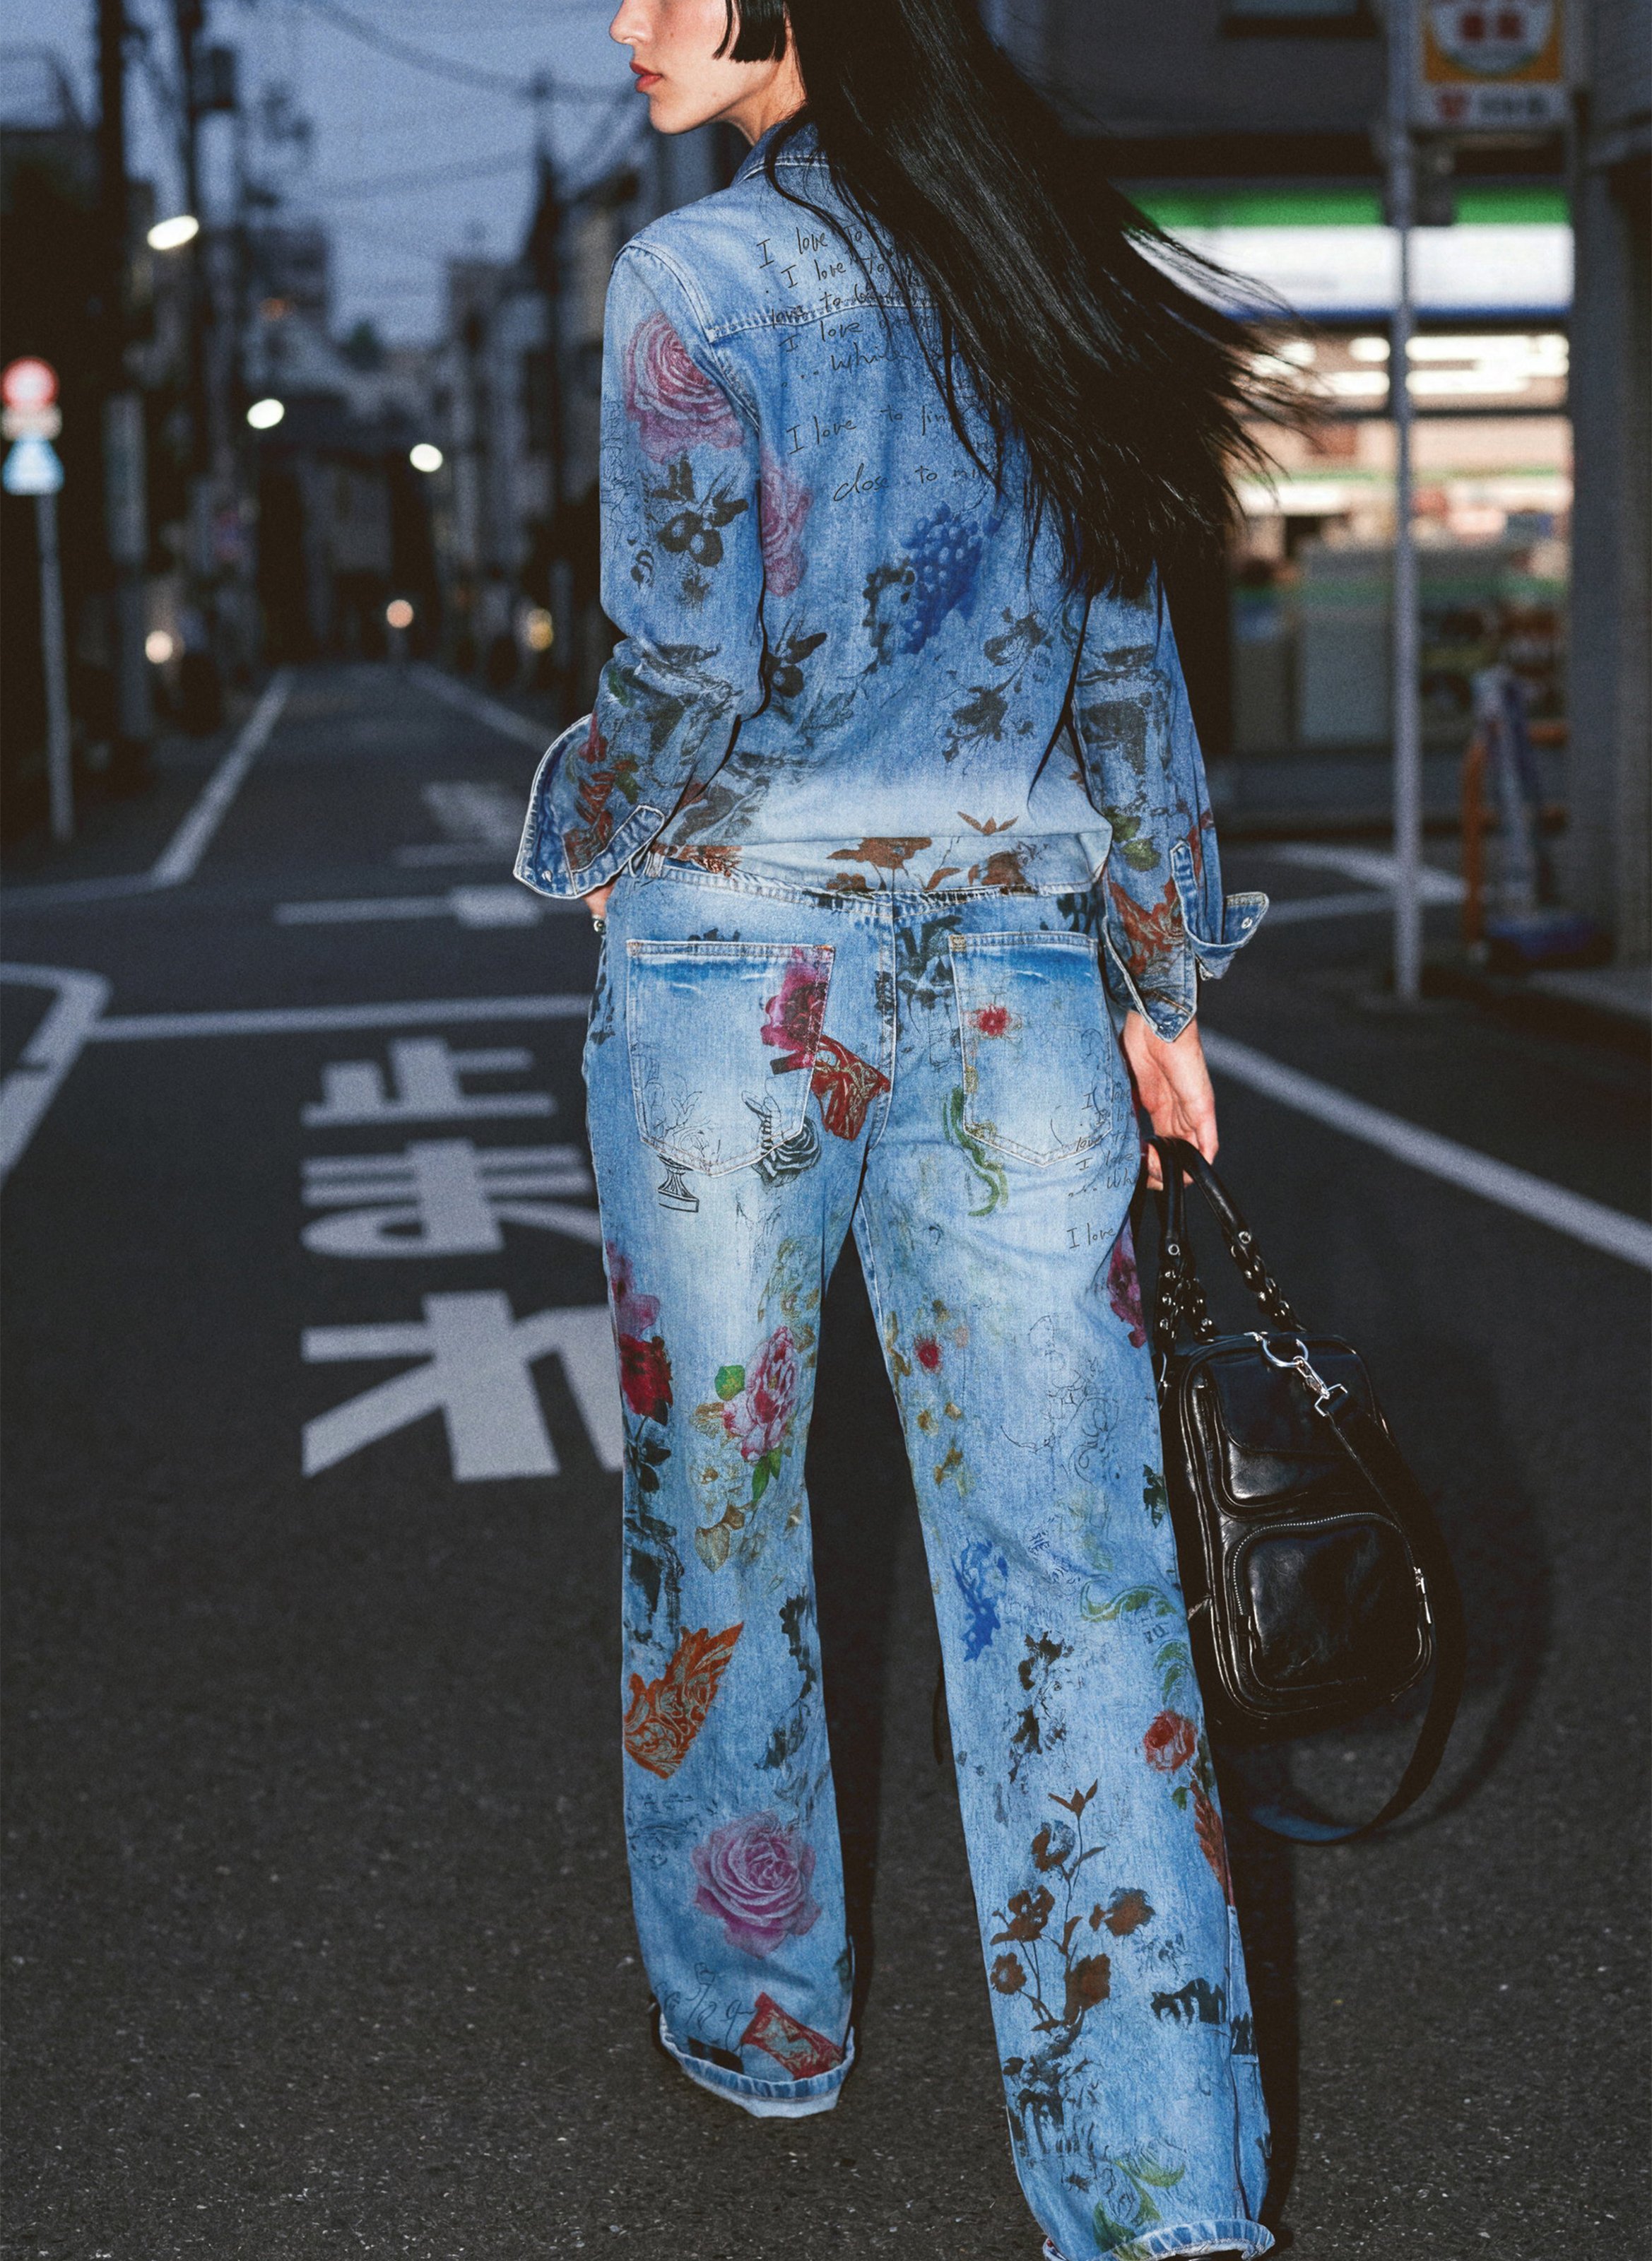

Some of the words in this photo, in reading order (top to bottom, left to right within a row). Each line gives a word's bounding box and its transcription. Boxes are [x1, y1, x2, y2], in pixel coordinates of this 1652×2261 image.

[757, 239, 774, 268] I
[796, 226, 828, 254] love
[781, 264, 798, 288] I
[814, 259, 846, 281] love
[820, 291, 841, 313] to
[779, 333, 799, 353] I
[819, 320, 863, 343] love
[786, 425, 805, 455] I
[814, 415, 857, 445] love
[880, 405, 903, 422] to
[833, 463, 889, 502] close
[1067, 1227, 1080, 1249] I
[1087, 1222, 1116, 1246] love
[300, 1036, 623, 1482] 止まれ
